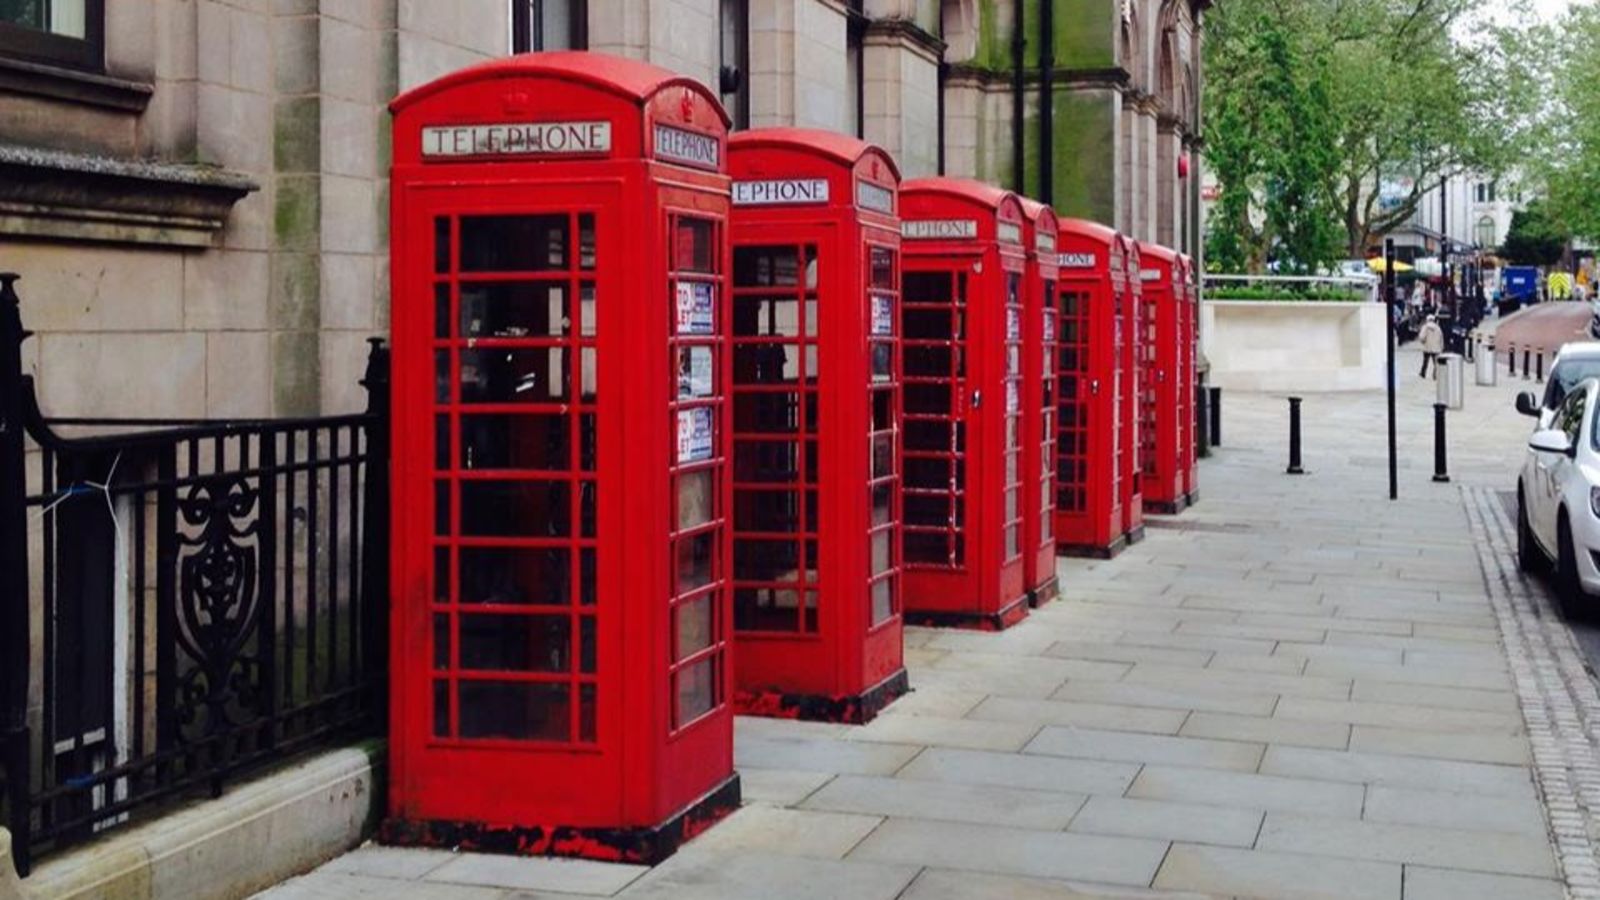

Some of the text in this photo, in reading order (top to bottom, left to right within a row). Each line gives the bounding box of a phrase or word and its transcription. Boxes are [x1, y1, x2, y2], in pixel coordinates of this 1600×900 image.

[431, 124, 605, 154] TELEPHONE
[656, 126, 717, 162] TELEPHONE
[736, 181, 826, 201] EPHONE
[904, 221, 975, 236] EPHONE
